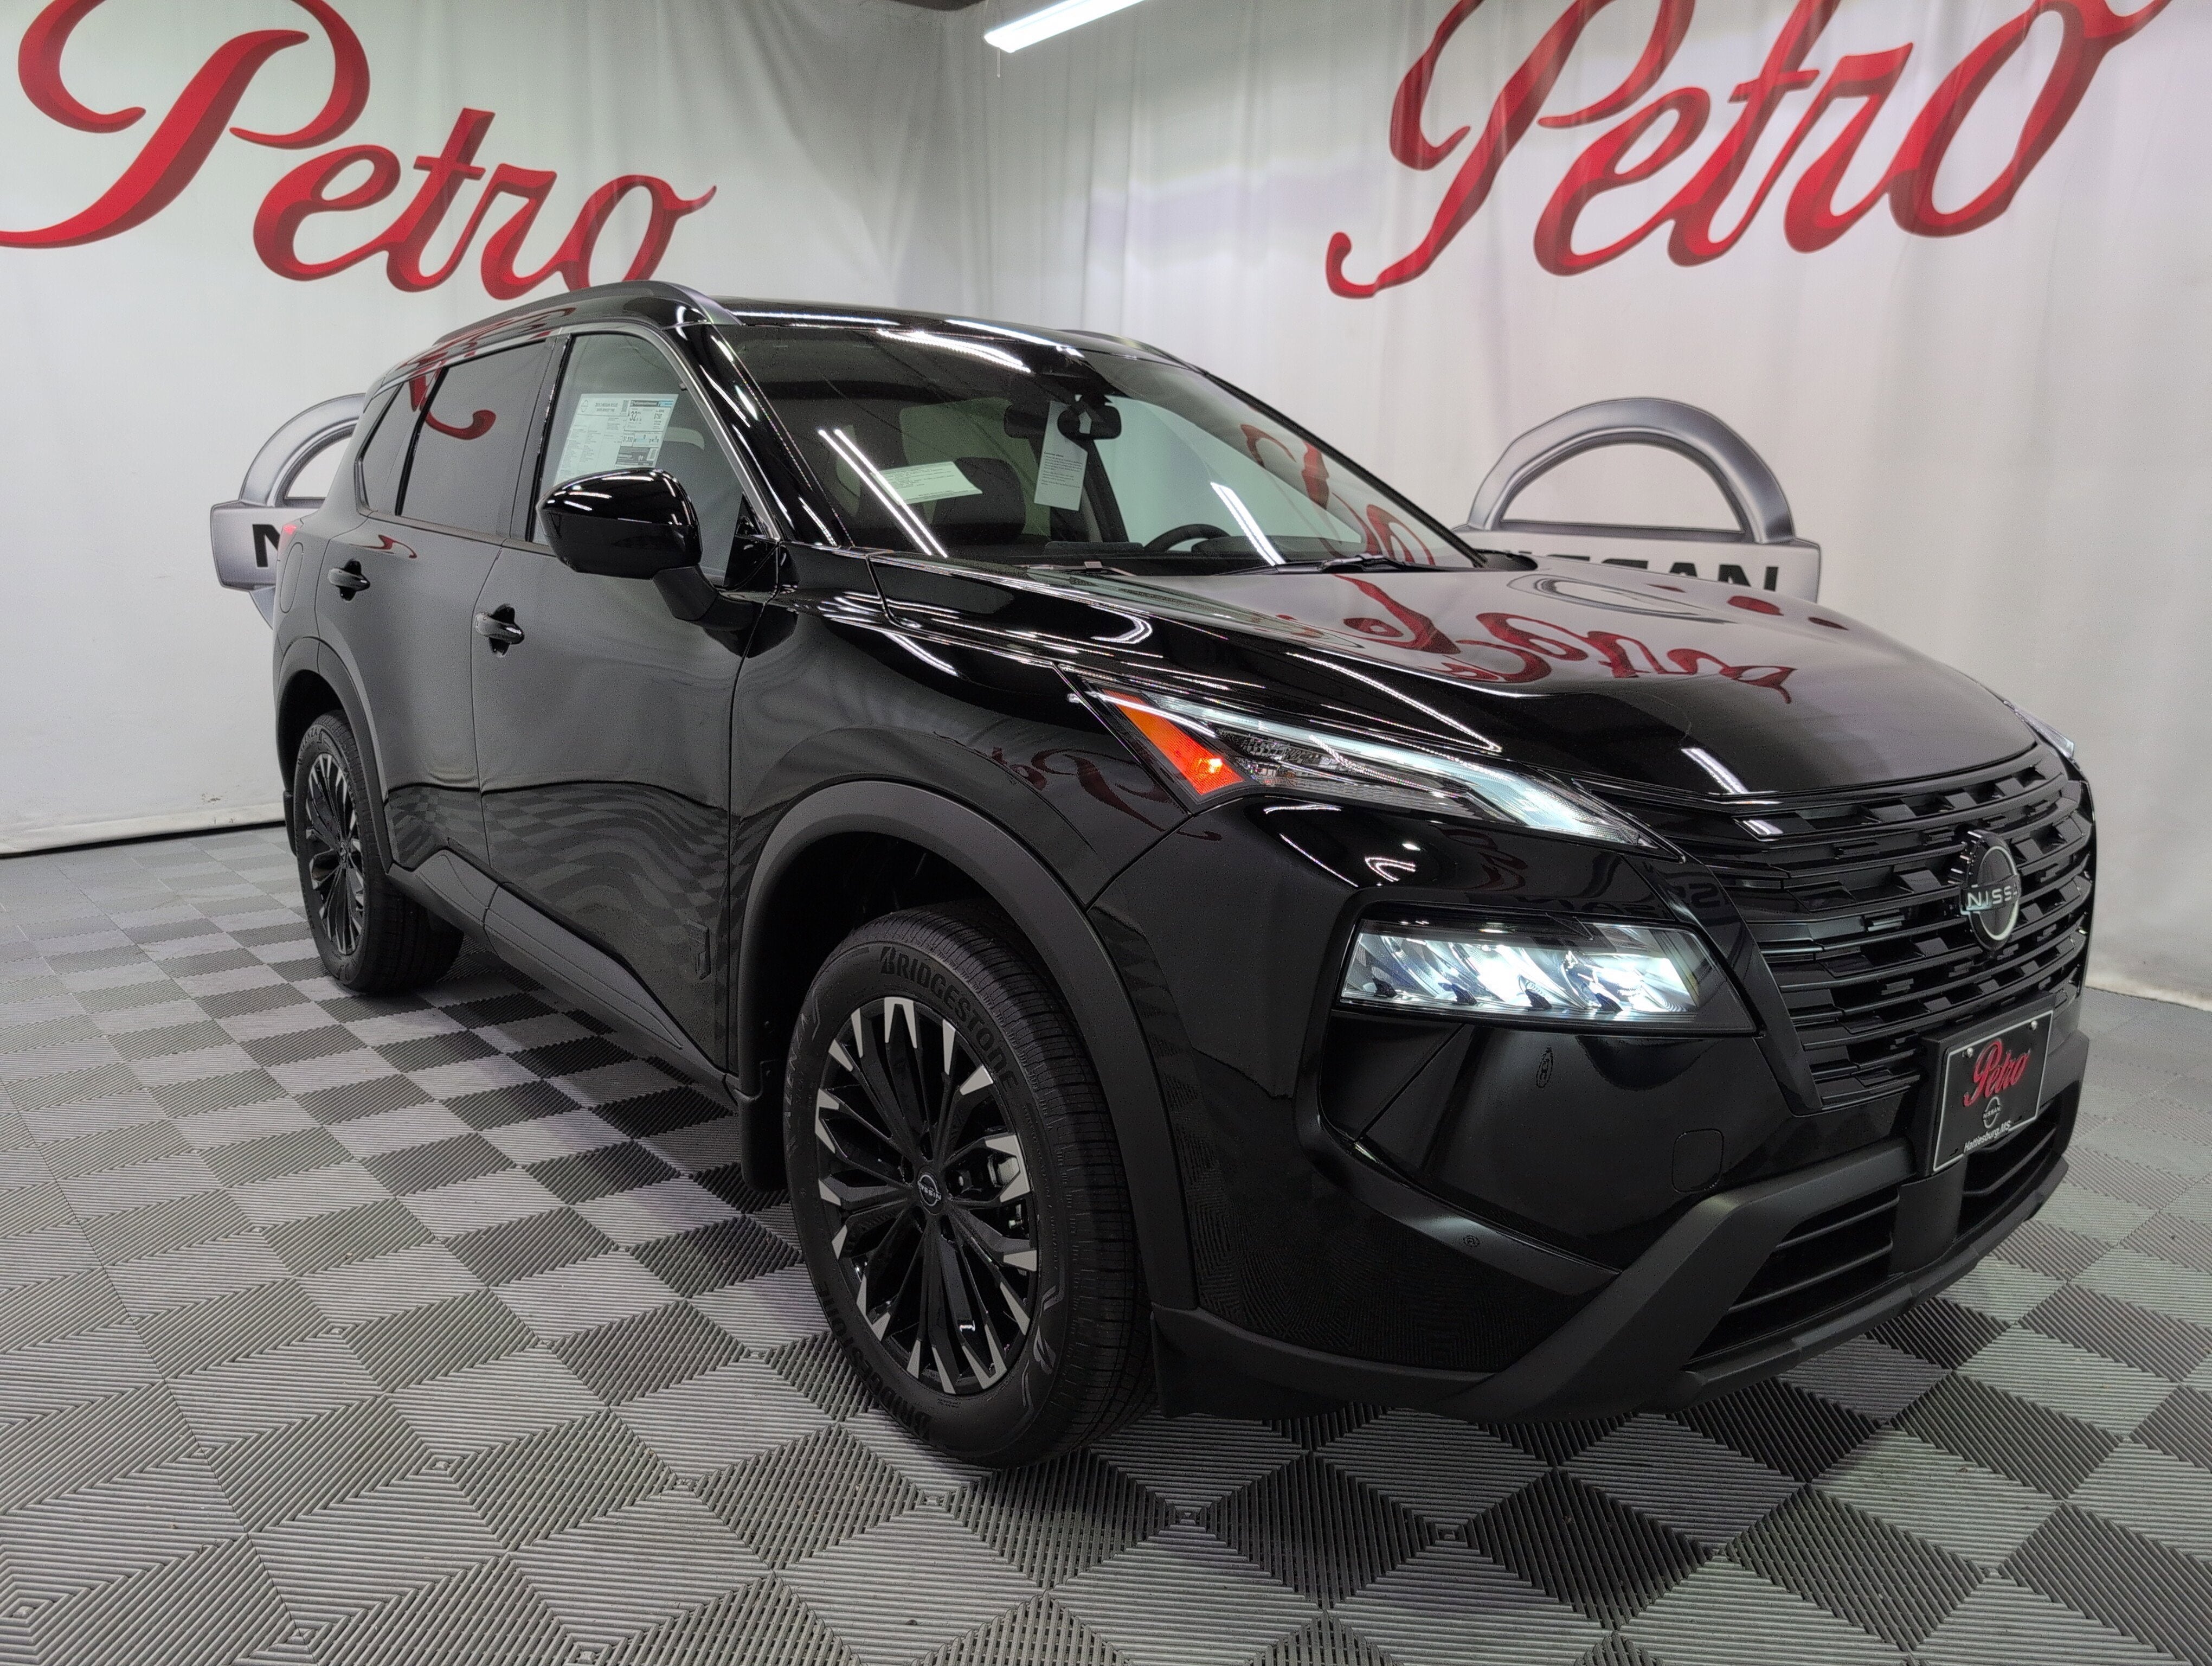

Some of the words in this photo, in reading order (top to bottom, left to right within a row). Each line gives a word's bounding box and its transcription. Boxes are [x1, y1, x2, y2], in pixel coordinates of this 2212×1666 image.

[0, 0, 717, 300] Petro
[1326, 0, 2174, 299] Petro
[1967, 884, 2018, 907] NISSA
[880, 946, 1019, 1093] BRIDGESTONE
[1963, 1037, 2032, 1107] Petro
